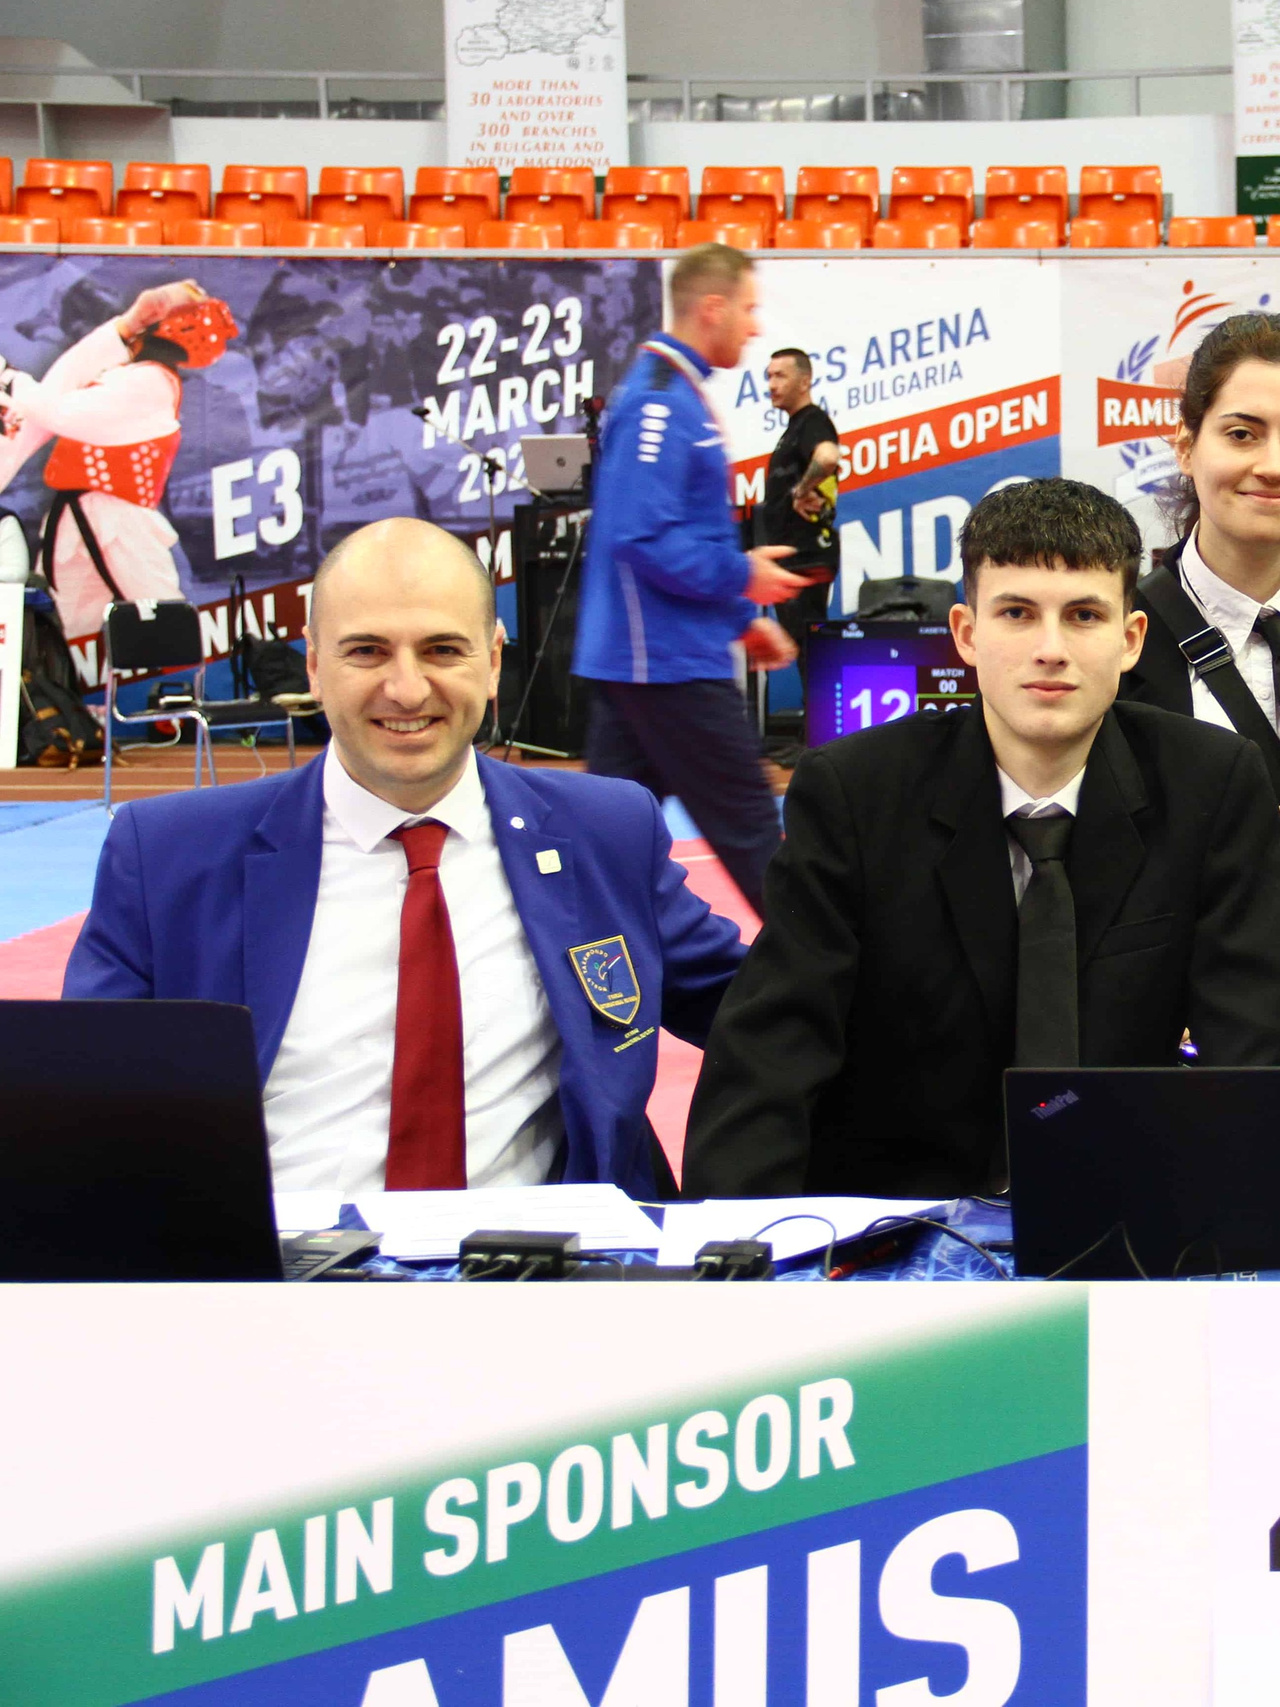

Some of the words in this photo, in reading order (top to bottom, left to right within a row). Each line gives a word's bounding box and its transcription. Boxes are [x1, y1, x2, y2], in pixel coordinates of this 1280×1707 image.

[469, 92, 491, 107] 30
[498, 94, 604, 107] LABORATORIES
[493, 79, 532, 91] MORE
[541, 79, 579, 91] THAN
[478, 122, 510, 137] 300
[522, 126, 597, 137] BRANCHES
[501, 110, 531, 121] AND
[537, 110, 575, 121] OVER
[465, 156, 517, 167] NORTH
[470, 141, 487, 152] IN
[494, 141, 566, 152] BULGARIA
[574, 141, 605, 152] AND
[436, 296, 583, 386] 22-23
[860, 307, 990, 374] ARENA
[847, 360, 963, 410] BULGARIA
[423, 359, 595, 450] MARCH
[1104, 398, 1182, 427] RAMU
[836, 422, 940, 483] SOFIA
[949, 389, 1049, 450] OPEN
[458, 441, 529, 504] 202
[211, 448, 304, 561] E3
[931, 669, 965, 678] MATCH
[938, 679, 958, 694] 00
[850, 688, 911, 730] 12
[151, 1497, 395, 1655] MAIN
[422, 1377, 858, 1577] SPONSOR
